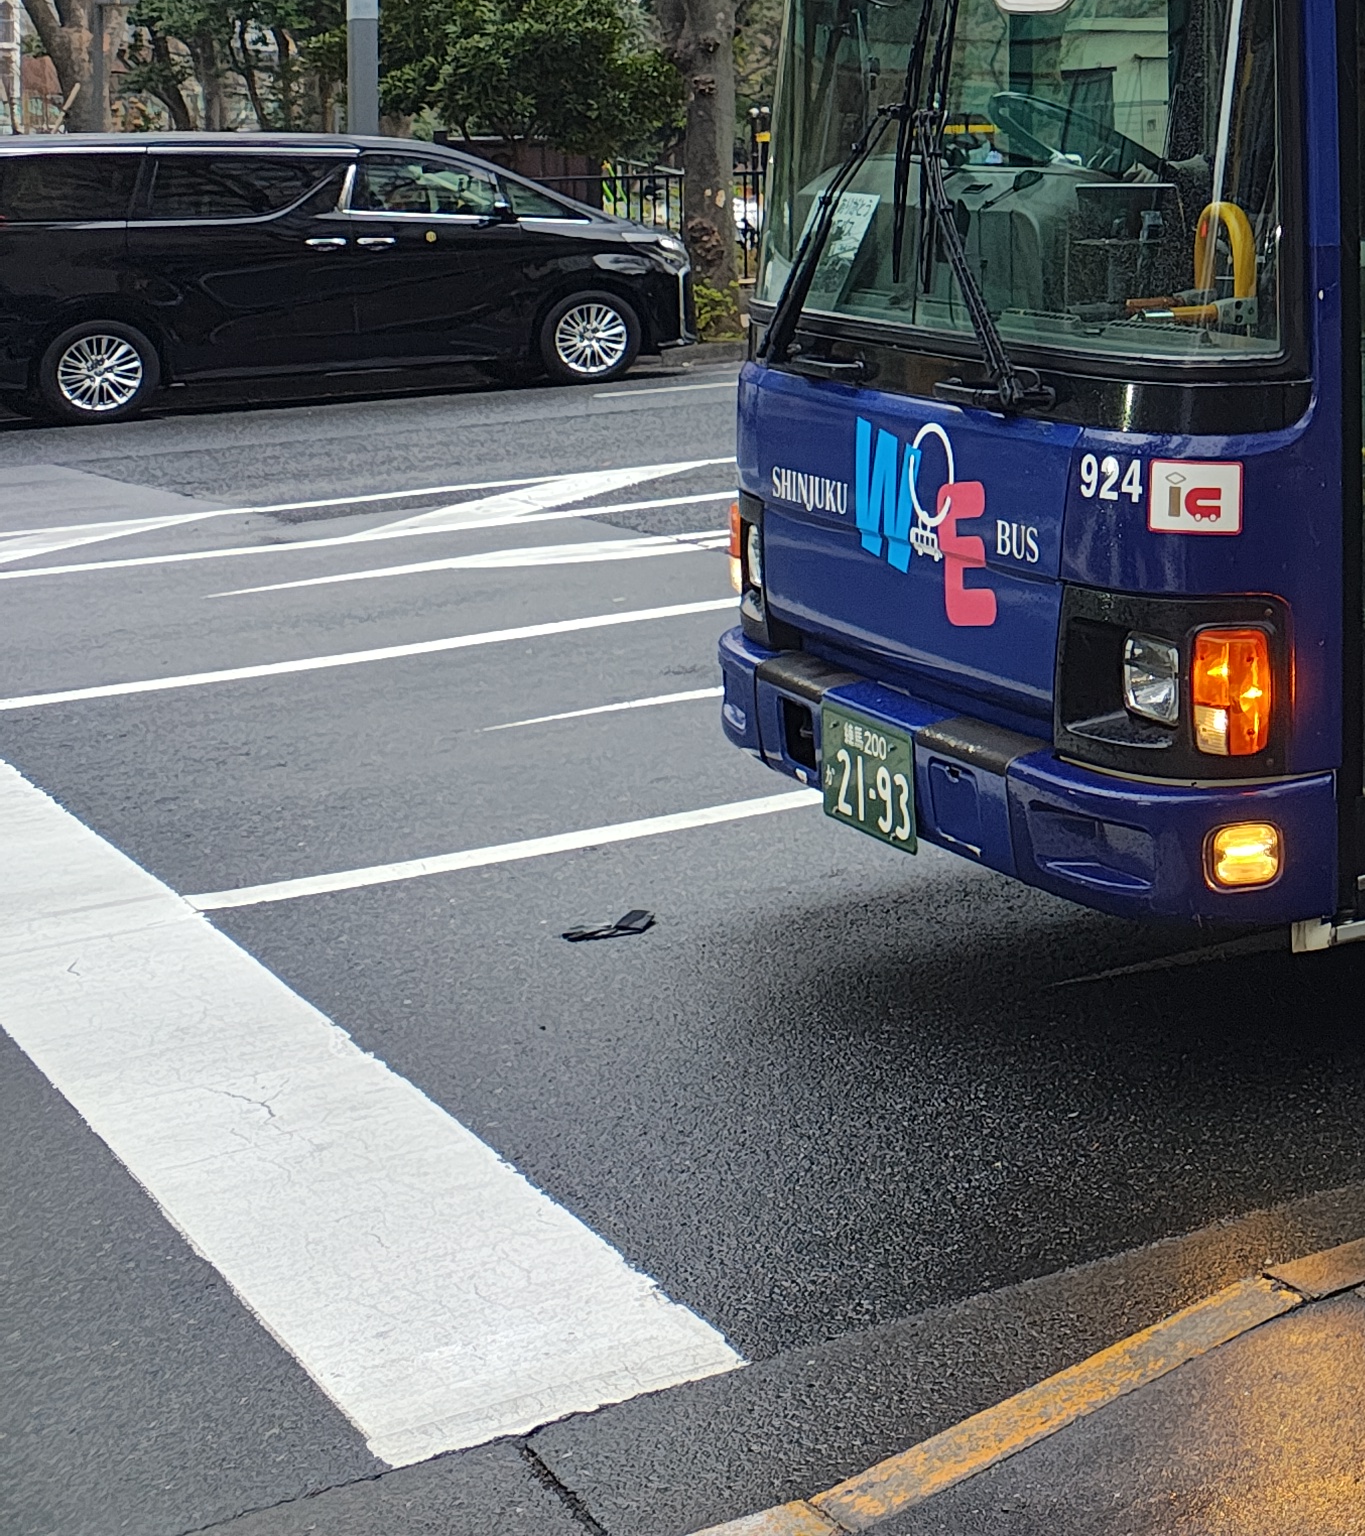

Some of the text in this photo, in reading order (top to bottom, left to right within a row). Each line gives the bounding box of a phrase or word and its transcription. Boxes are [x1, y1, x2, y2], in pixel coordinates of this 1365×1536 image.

[772, 465, 849, 516] SHINJUKU
[996, 518, 1040, 564] BUS
[1080, 452, 1143, 503] 924
[836, 748, 911, 841] 21-93
